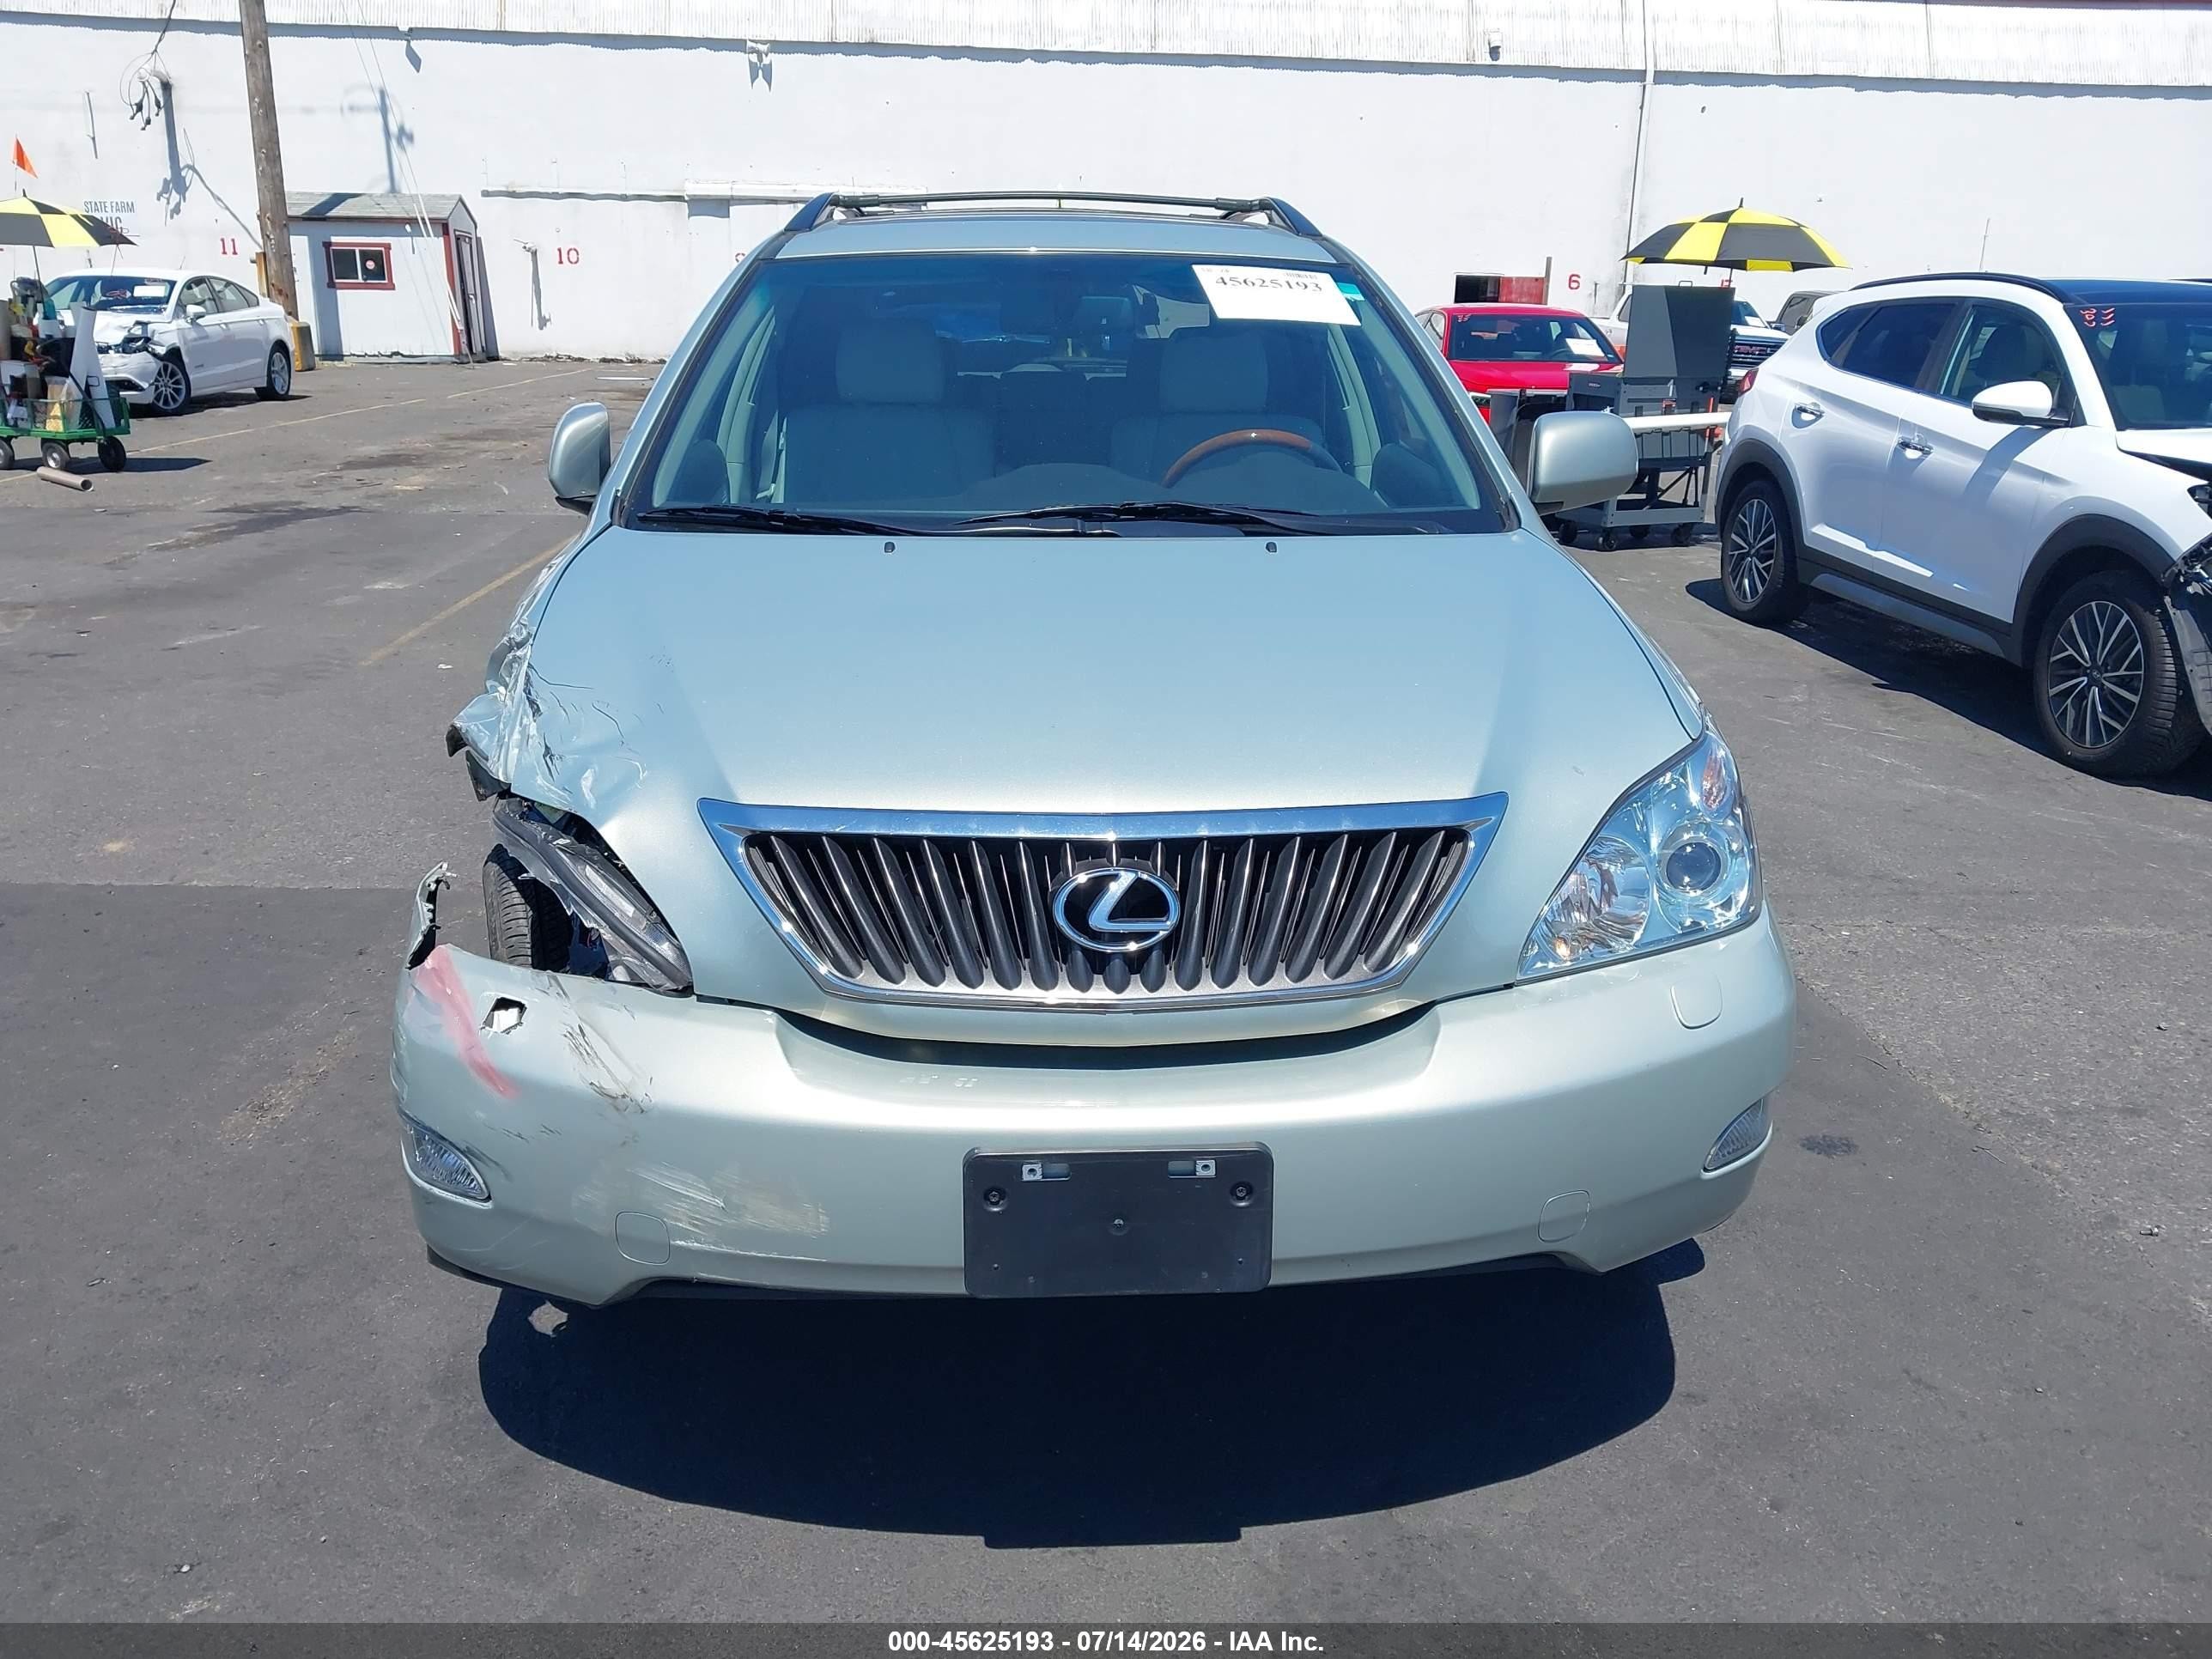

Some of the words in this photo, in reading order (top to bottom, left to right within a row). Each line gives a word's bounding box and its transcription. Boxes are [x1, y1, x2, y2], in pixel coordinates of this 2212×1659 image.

[84, 201, 108, 213] STATE
[110, 202, 135, 213] FARM
[220, 238, 238, 255] 11
[556, 247, 580, 264] 10
[1215, 276, 1323, 293] 45625193
[1568, 274, 1581, 289] 6
